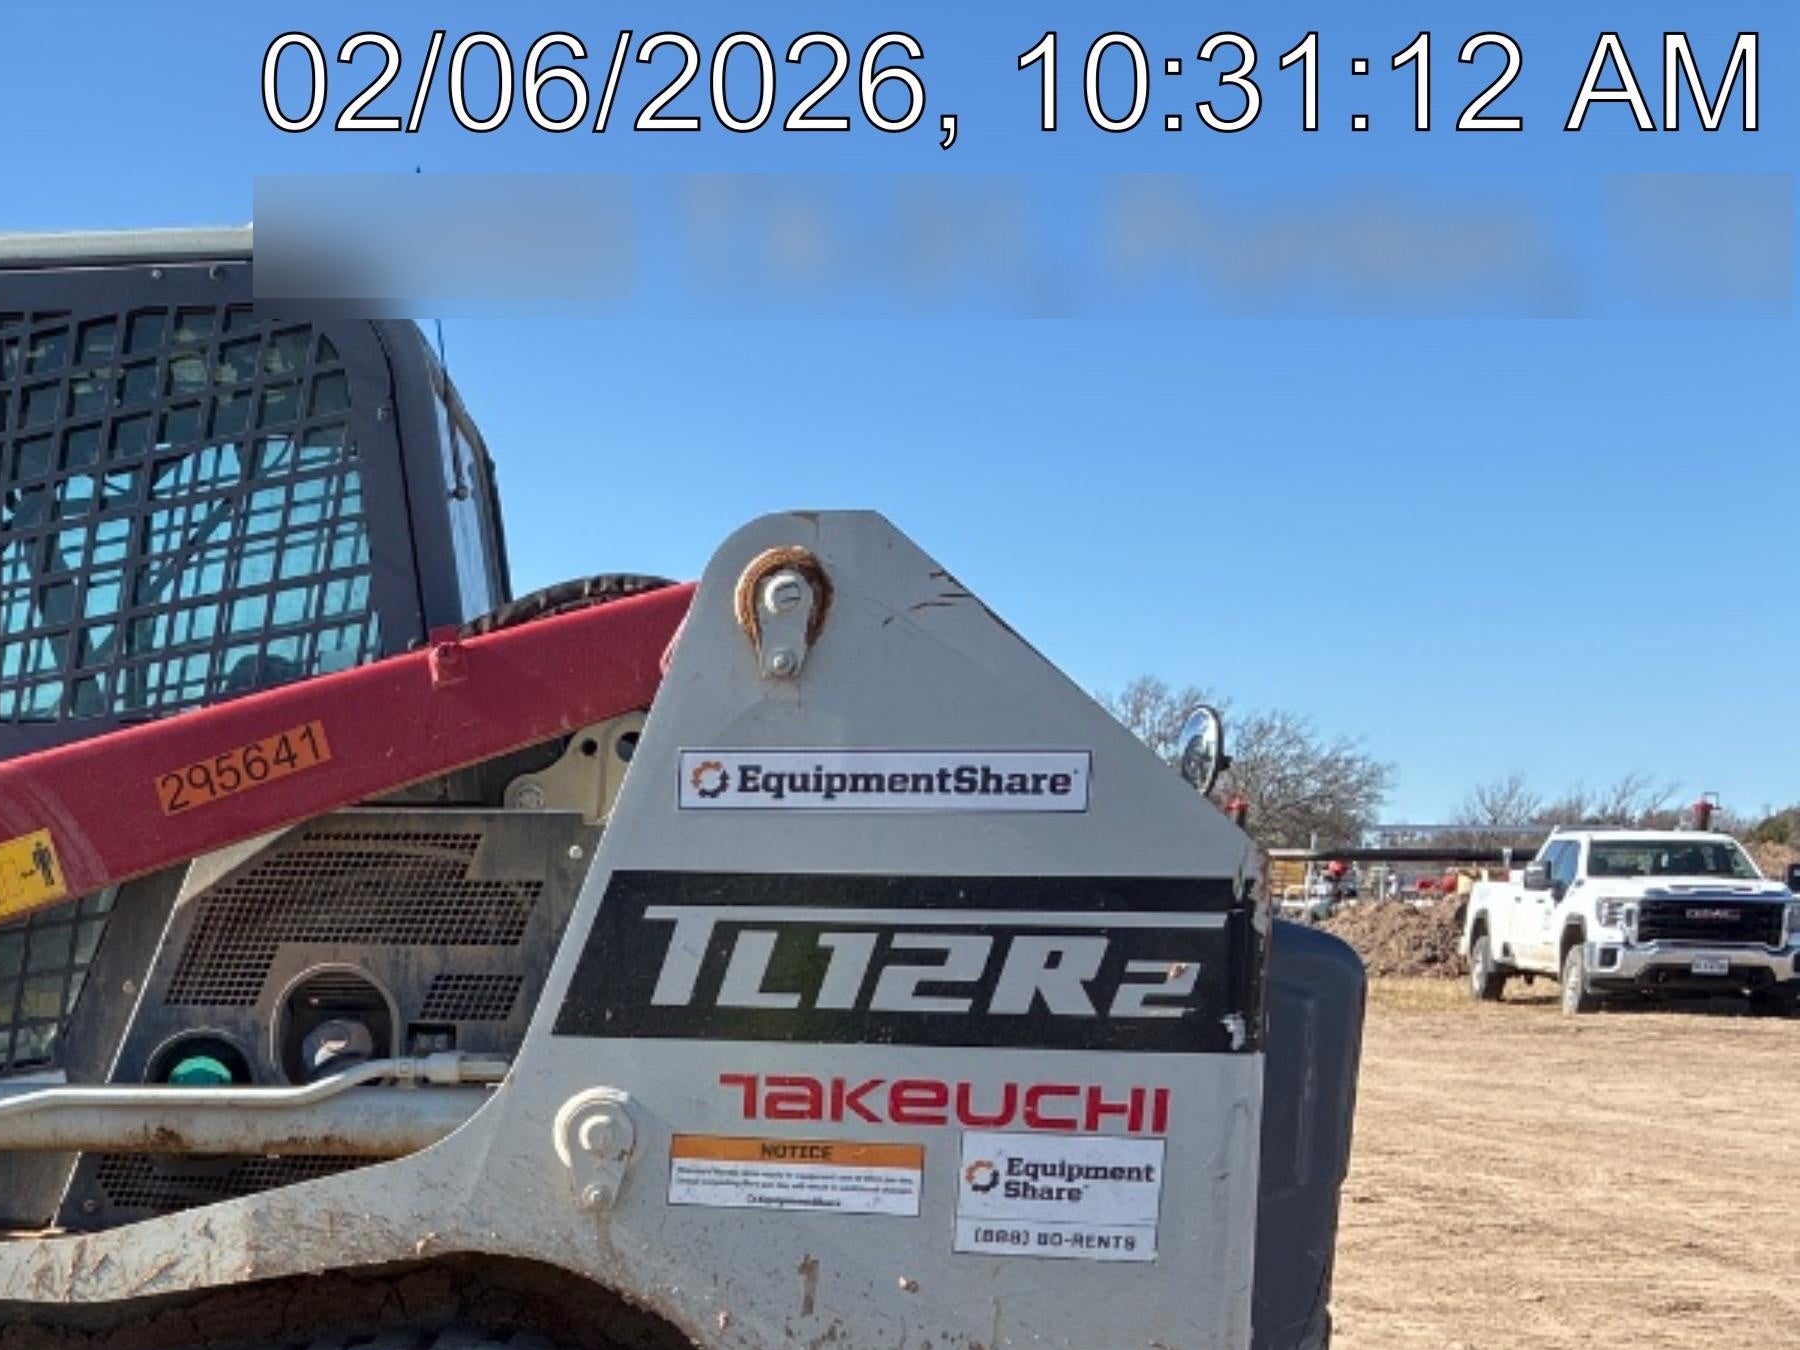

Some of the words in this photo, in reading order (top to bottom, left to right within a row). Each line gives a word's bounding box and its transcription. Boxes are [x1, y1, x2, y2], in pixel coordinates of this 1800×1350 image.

[160, 724, 325, 813] 295641
[736, 764, 1073, 799] EquipmentShare
[643, 905, 1228, 1019] TL12R2
[761, 1143, 833, 1160] NOTICE
[1005, 1157, 1155, 1183] Equipment
[1003, 1181, 1084, 1201] Share
